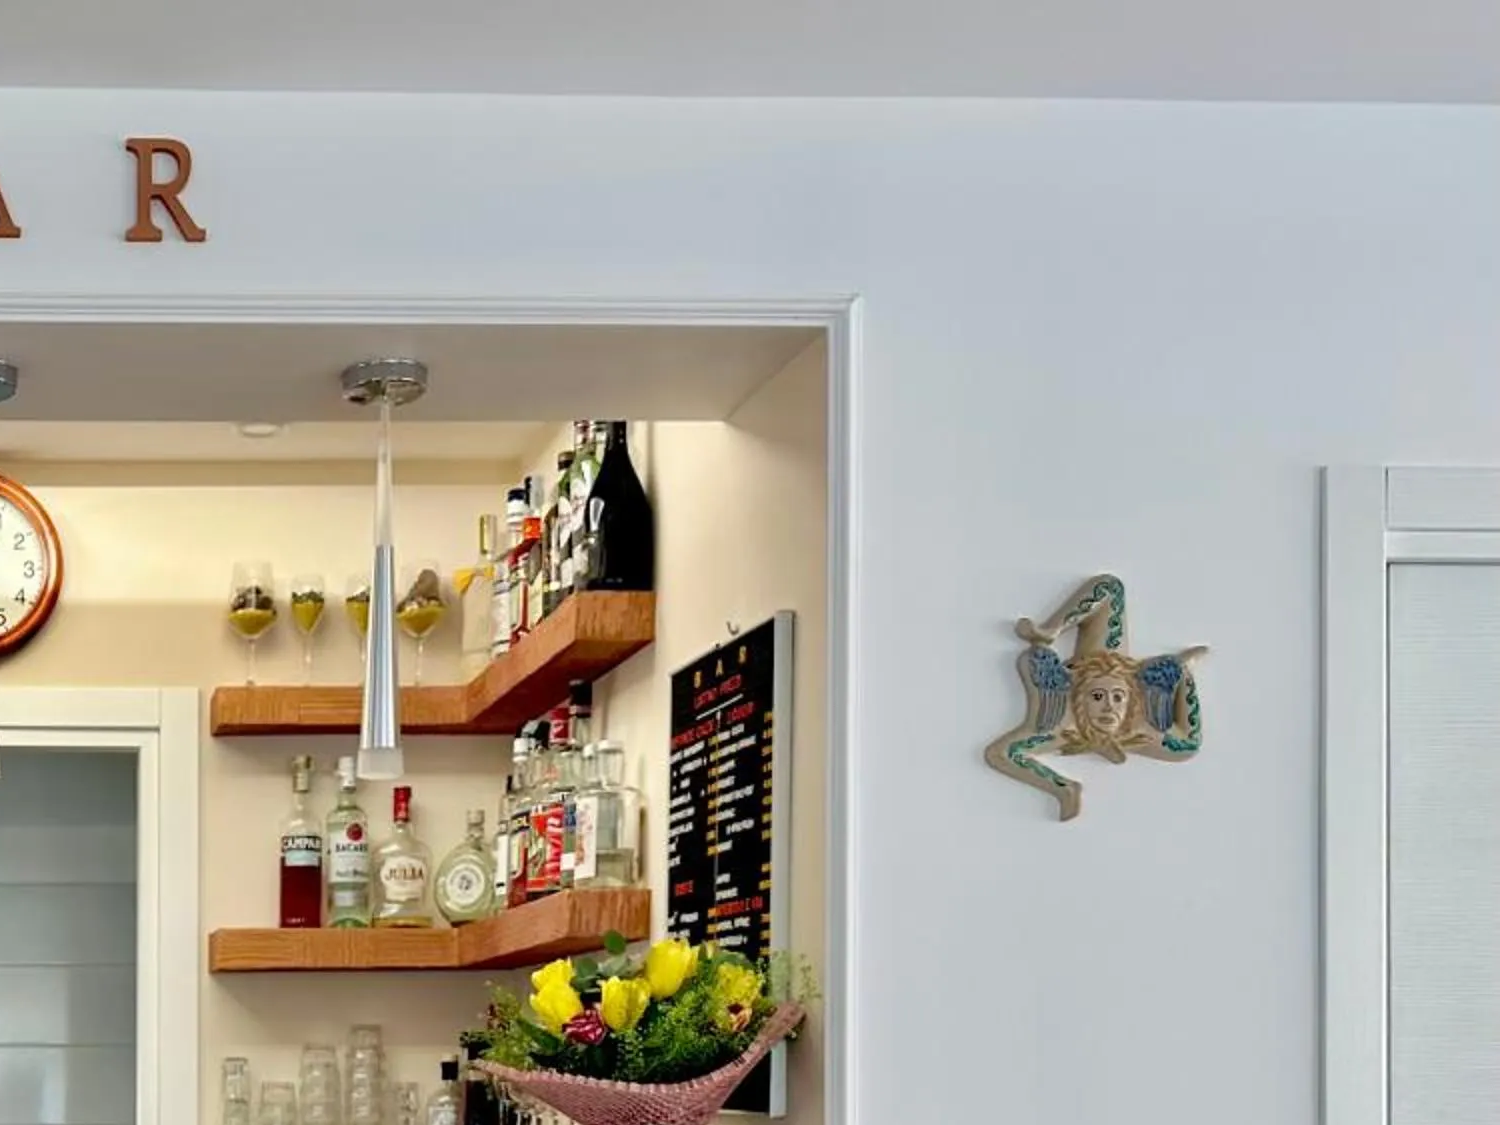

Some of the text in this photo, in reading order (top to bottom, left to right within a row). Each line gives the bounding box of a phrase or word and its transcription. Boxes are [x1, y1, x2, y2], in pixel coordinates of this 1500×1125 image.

[13, 533, 26, 551] 2
[23, 560, 35, 579] 3
[13, 588, 26, 605] 4
